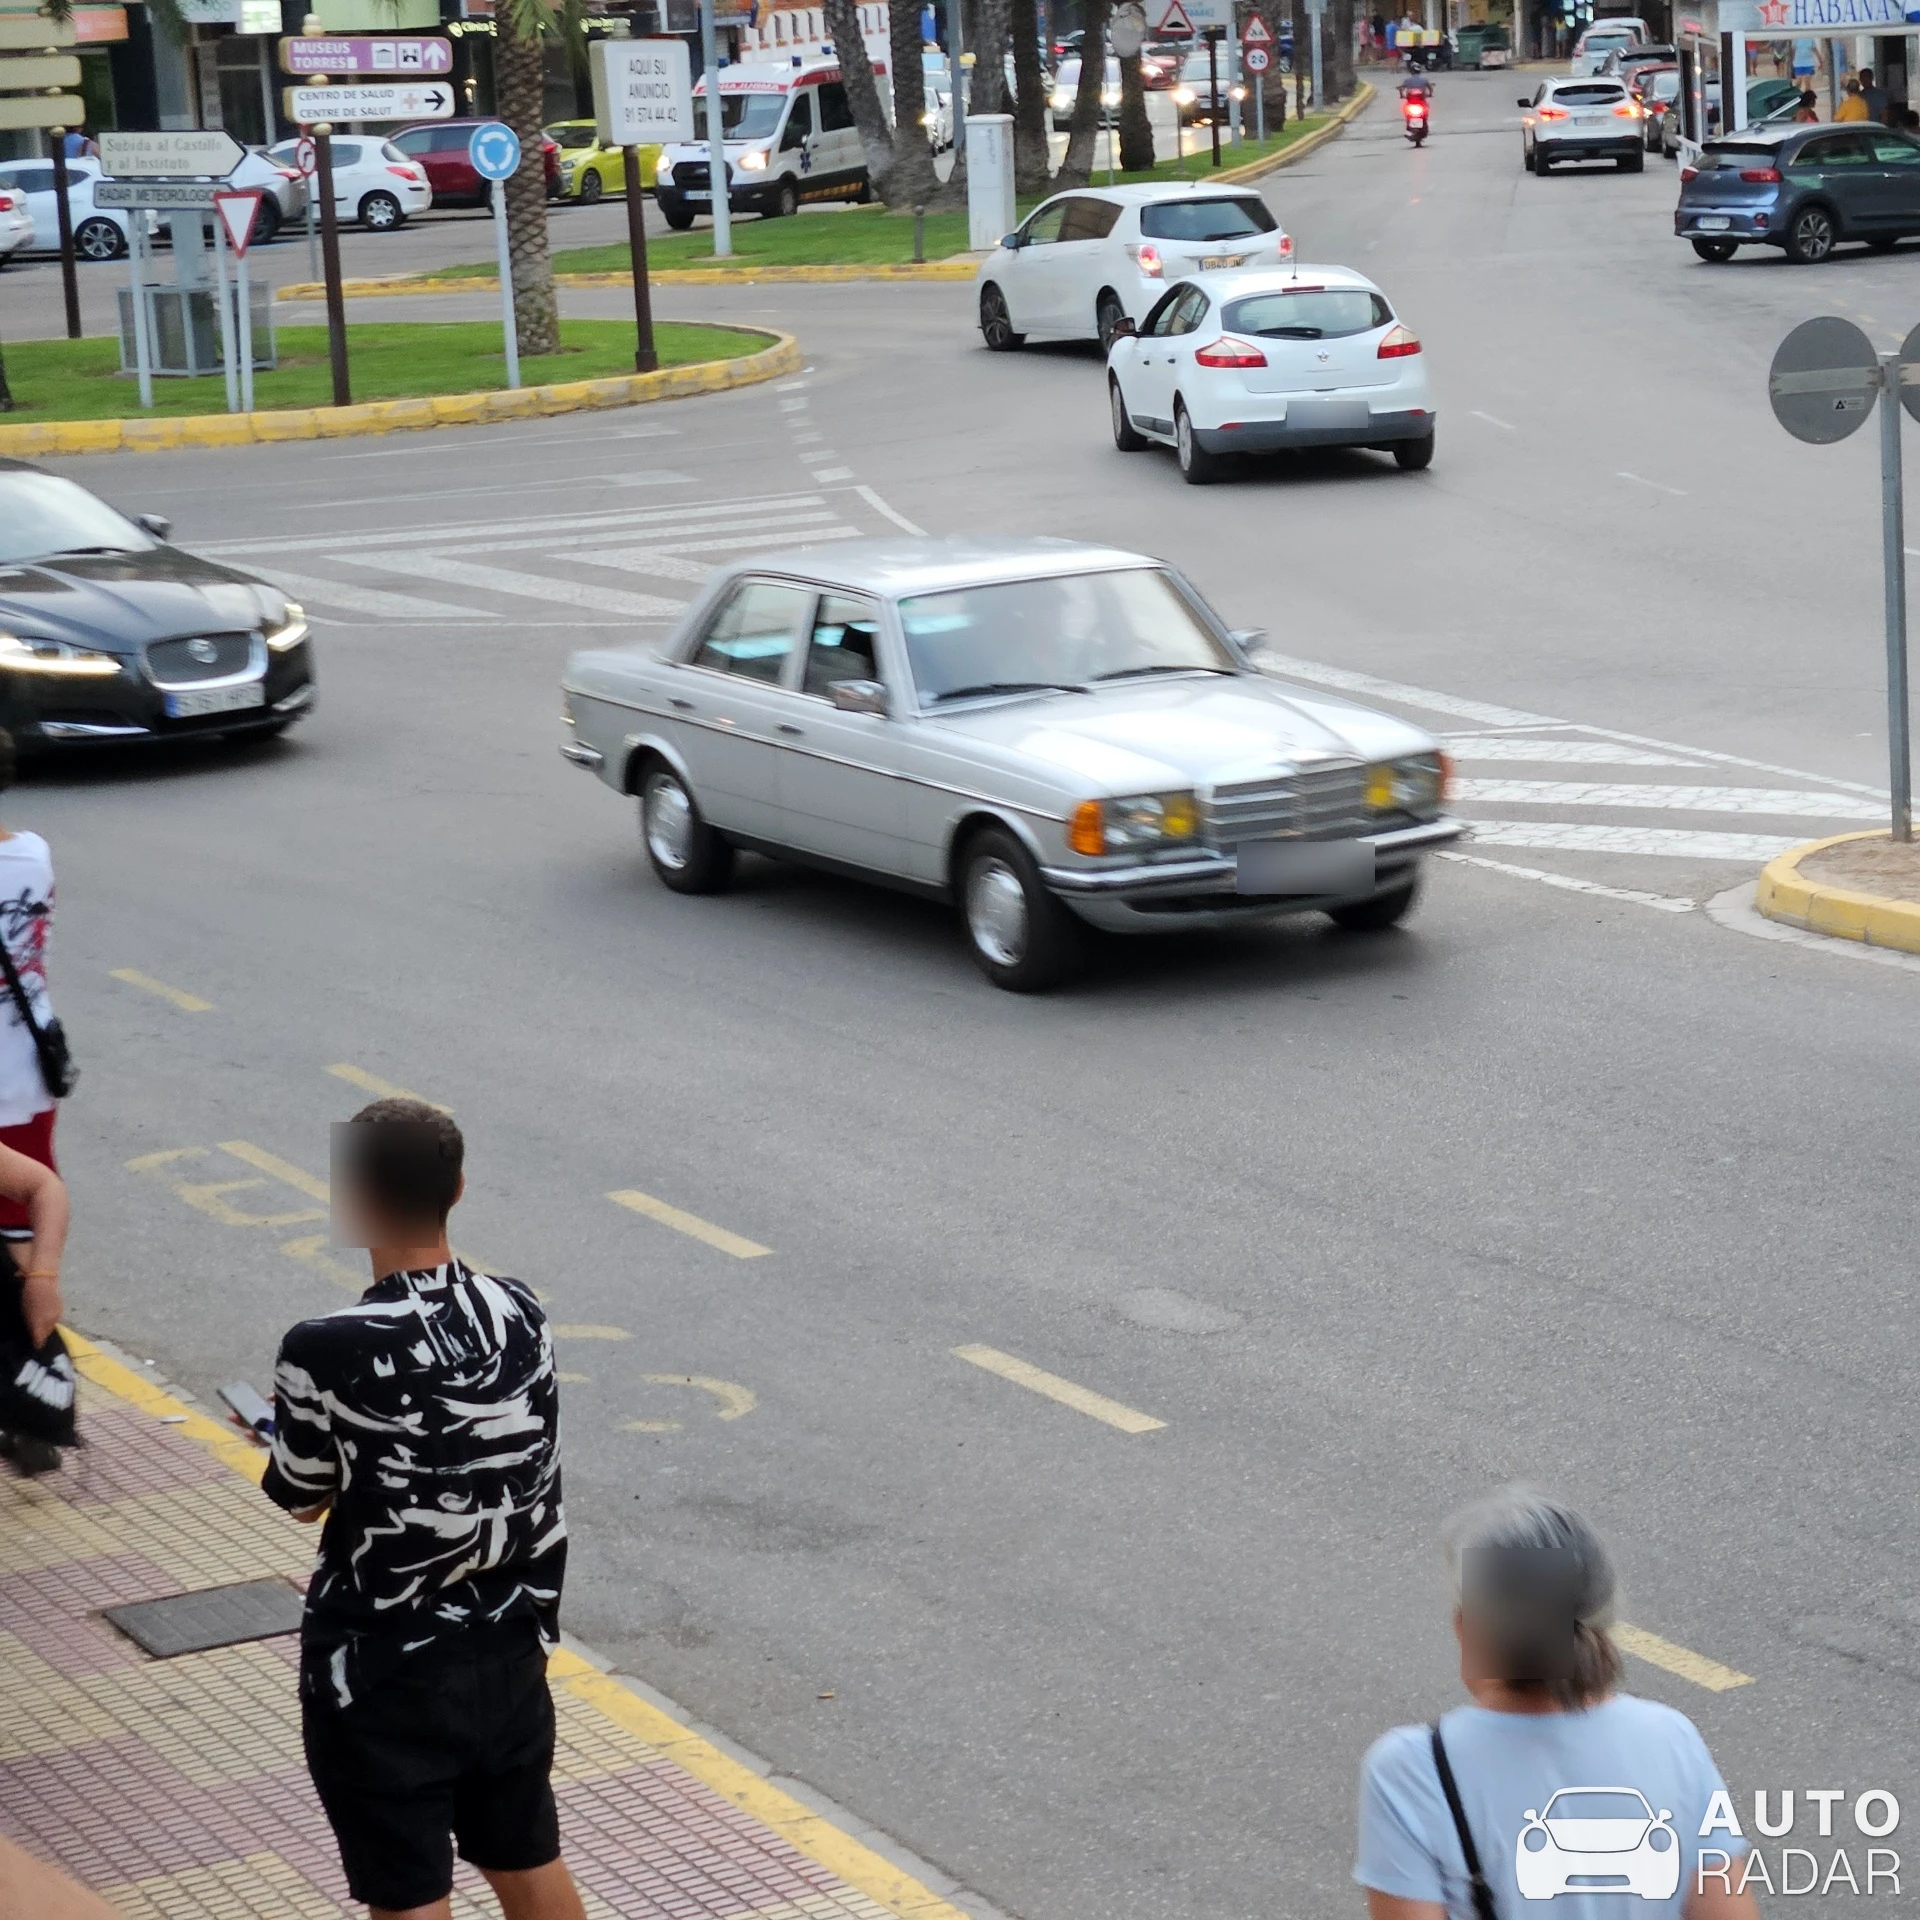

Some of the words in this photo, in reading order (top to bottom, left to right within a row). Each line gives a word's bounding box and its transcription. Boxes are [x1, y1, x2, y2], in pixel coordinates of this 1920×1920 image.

[293, 41, 350, 54] MUSEUS
[294, 57, 346, 69] TORRES
[1251, 54, 1265, 64] 20
[654, 59, 667, 75] SU
[298, 90, 341, 101] CENTRO
[344, 90, 357, 100] DE
[361, 89, 395, 99] SALUD
[629, 83, 671, 99] ANUNCIO
[300, 108, 340, 118] CENTRE
[344, 108, 357, 117] DE
[361, 107, 392, 117] SALUT
[625, 107, 634, 123] 91
[668, 107, 678, 122] 42
[107, 138, 151, 152] Subida
[157, 138, 169, 151] al
[174, 138, 222, 151] Castillo
[106, 160, 113, 172] y
[119, 156, 130, 169] al
[136, 156, 190, 169] Instituto
[98, 188, 132, 201] RADAR
